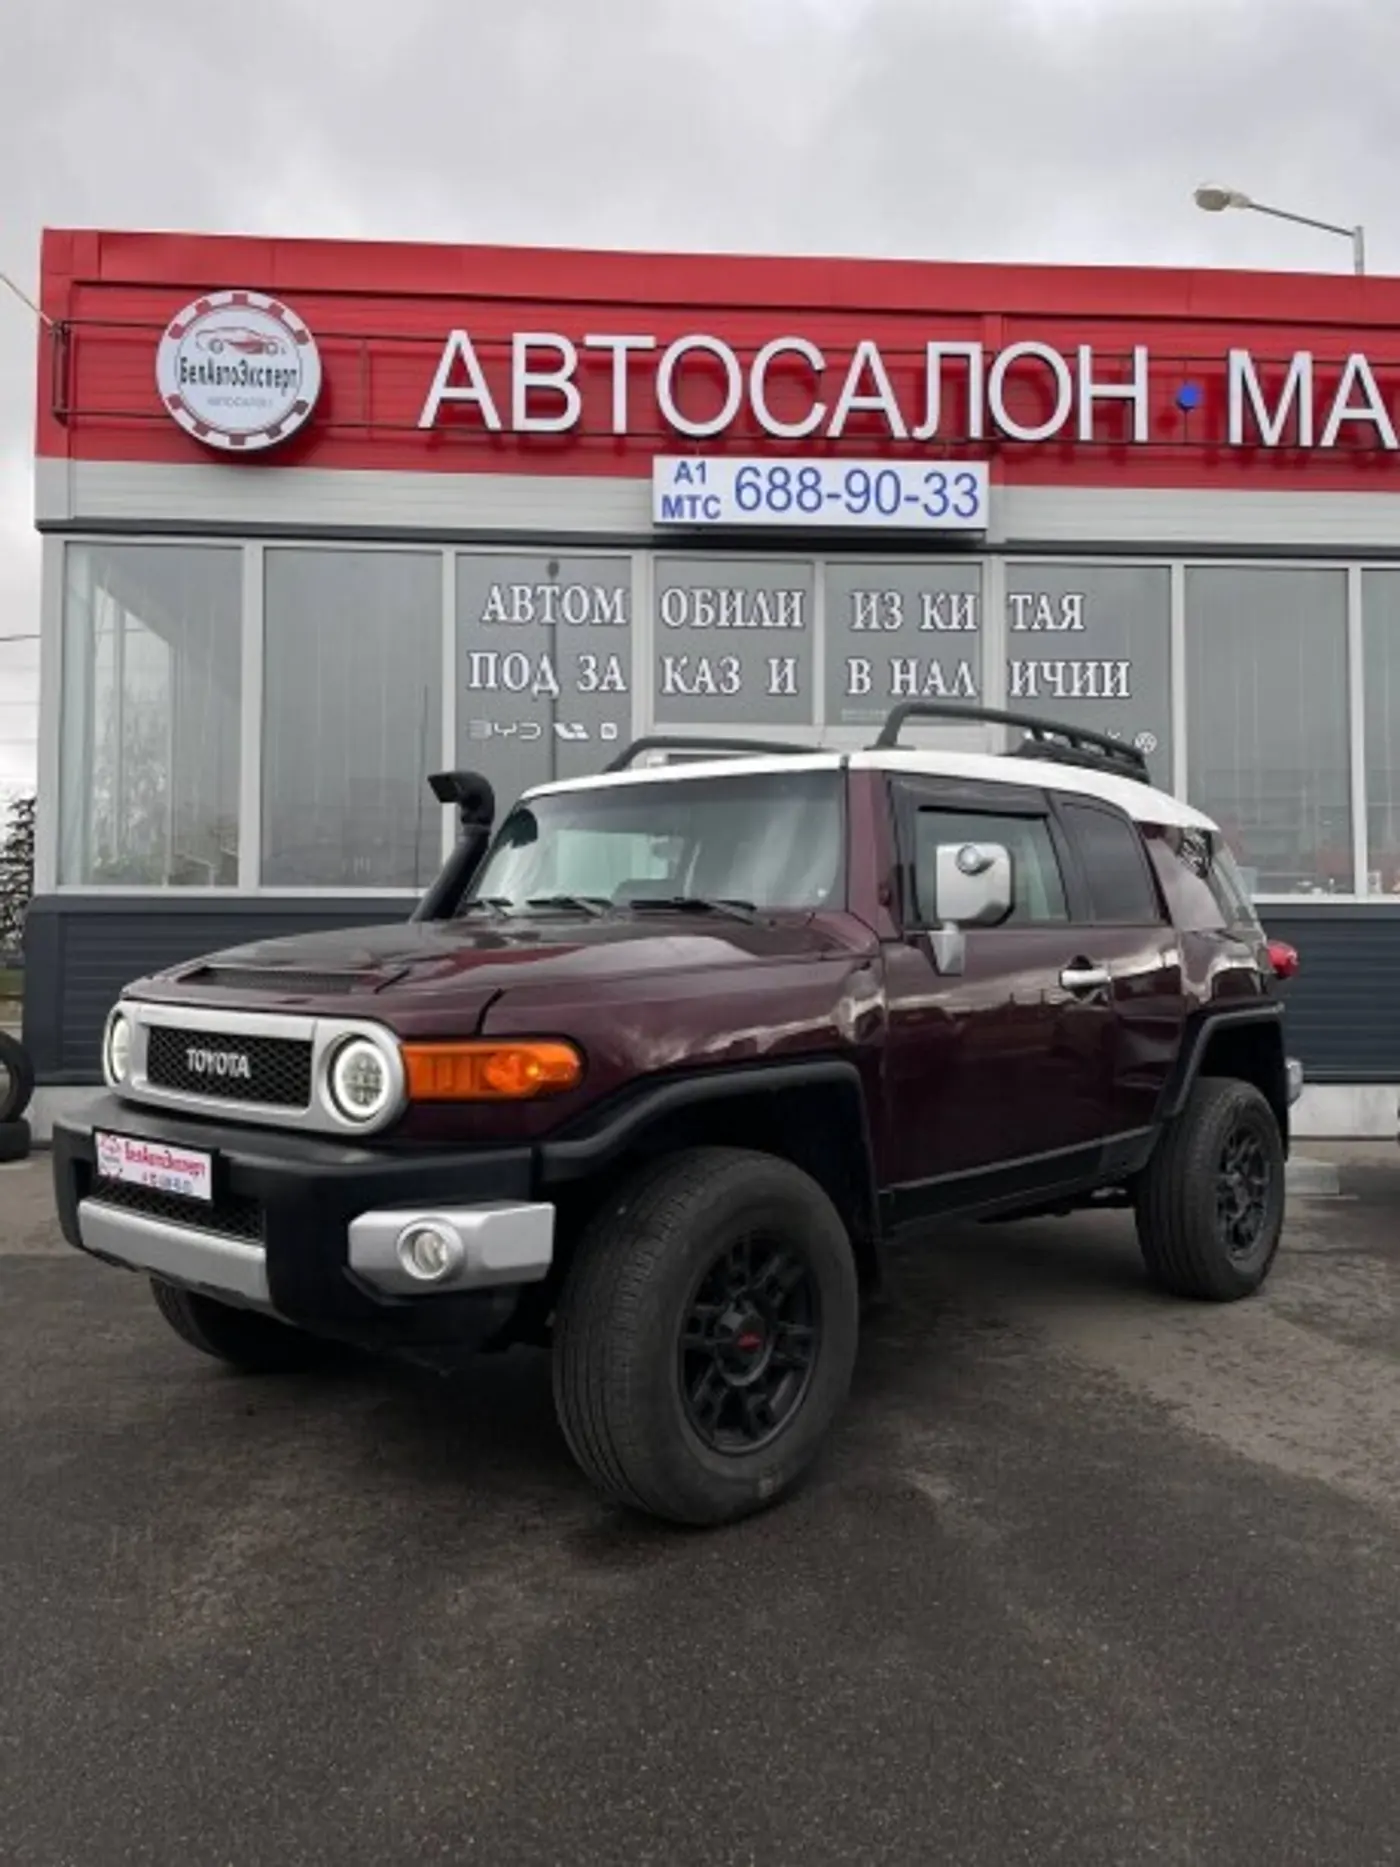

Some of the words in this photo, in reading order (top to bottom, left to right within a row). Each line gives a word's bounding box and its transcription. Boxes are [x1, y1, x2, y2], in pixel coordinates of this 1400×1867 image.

[418, 329, 1149, 442] АВТОСАЛОН
[661, 494, 721, 520] МТС
[734, 465, 980, 518] 688-90-33
[850, 591, 904, 631] ИЗ
[469, 652, 561, 699] ПОД
[767, 657, 798, 695] И
[847, 658, 873, 695] В
[185, 1046, 252, 1079] TOYOTA
